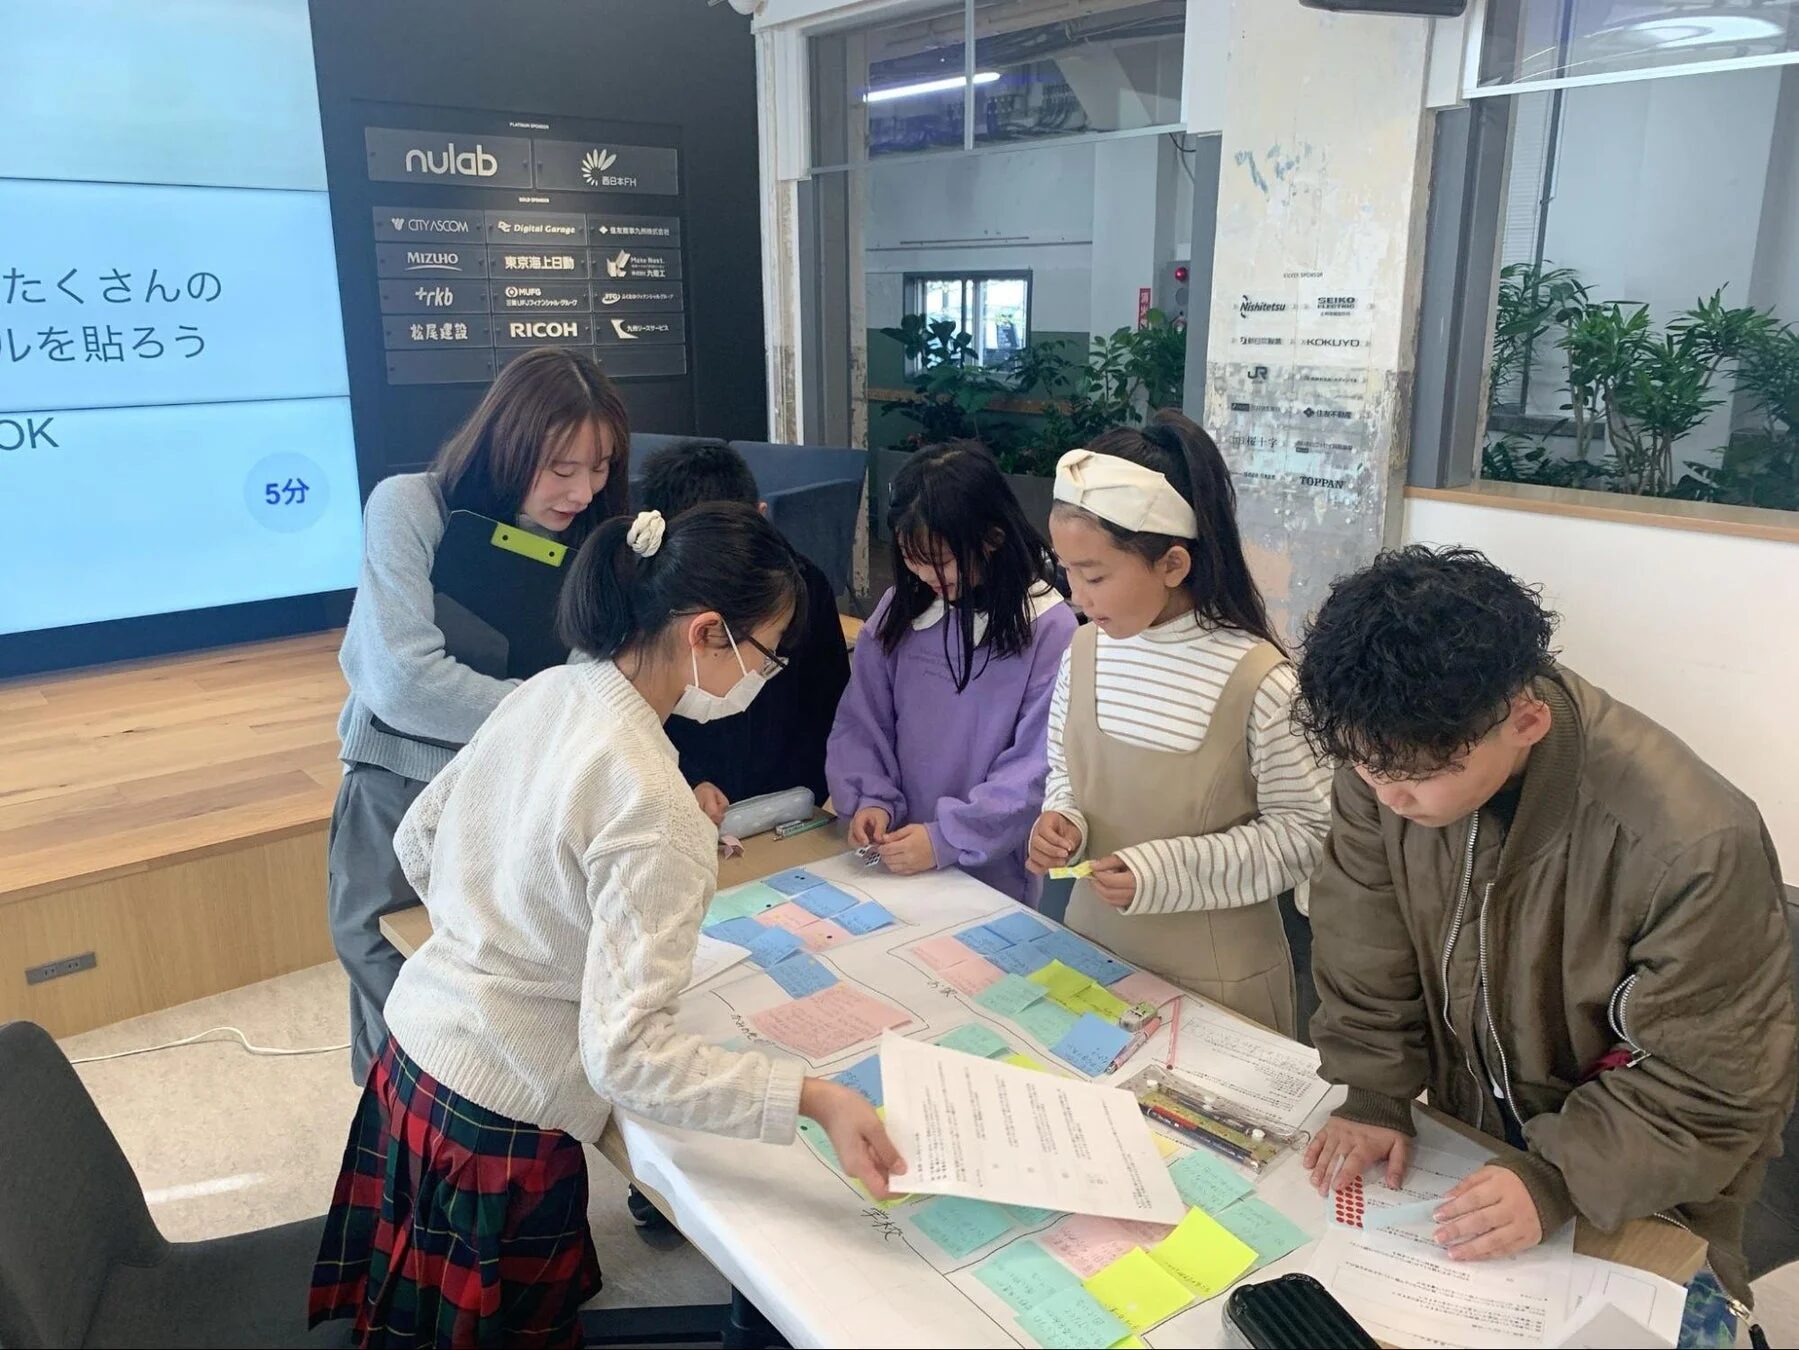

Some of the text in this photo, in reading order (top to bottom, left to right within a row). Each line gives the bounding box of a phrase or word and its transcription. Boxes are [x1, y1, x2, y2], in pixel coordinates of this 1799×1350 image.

[405, 142, 498, 177] nulab
[513, 224, 576, 235] Digital Garage
[407, 251, 459, 265] MIZUHO
[504, 255, 575, 270] 東京海上日動
[2, 266, 222, 305] たくさんの
[518, 287, 542, 296] MUFG
[1239, 301, 1286, 312] Nishitetsu
[410, 322, 469, 341] 松尾建設
[509, 321, 578, 338] RICOH
[1306, 338, 1360, 348] KOKUYO
[1247, 366, 1268, 380] JR
[0, 416, 60, 451] OK
[1300, 475, 1345, 490] TOPPAN
[264, 476, 310, 506] 5分
